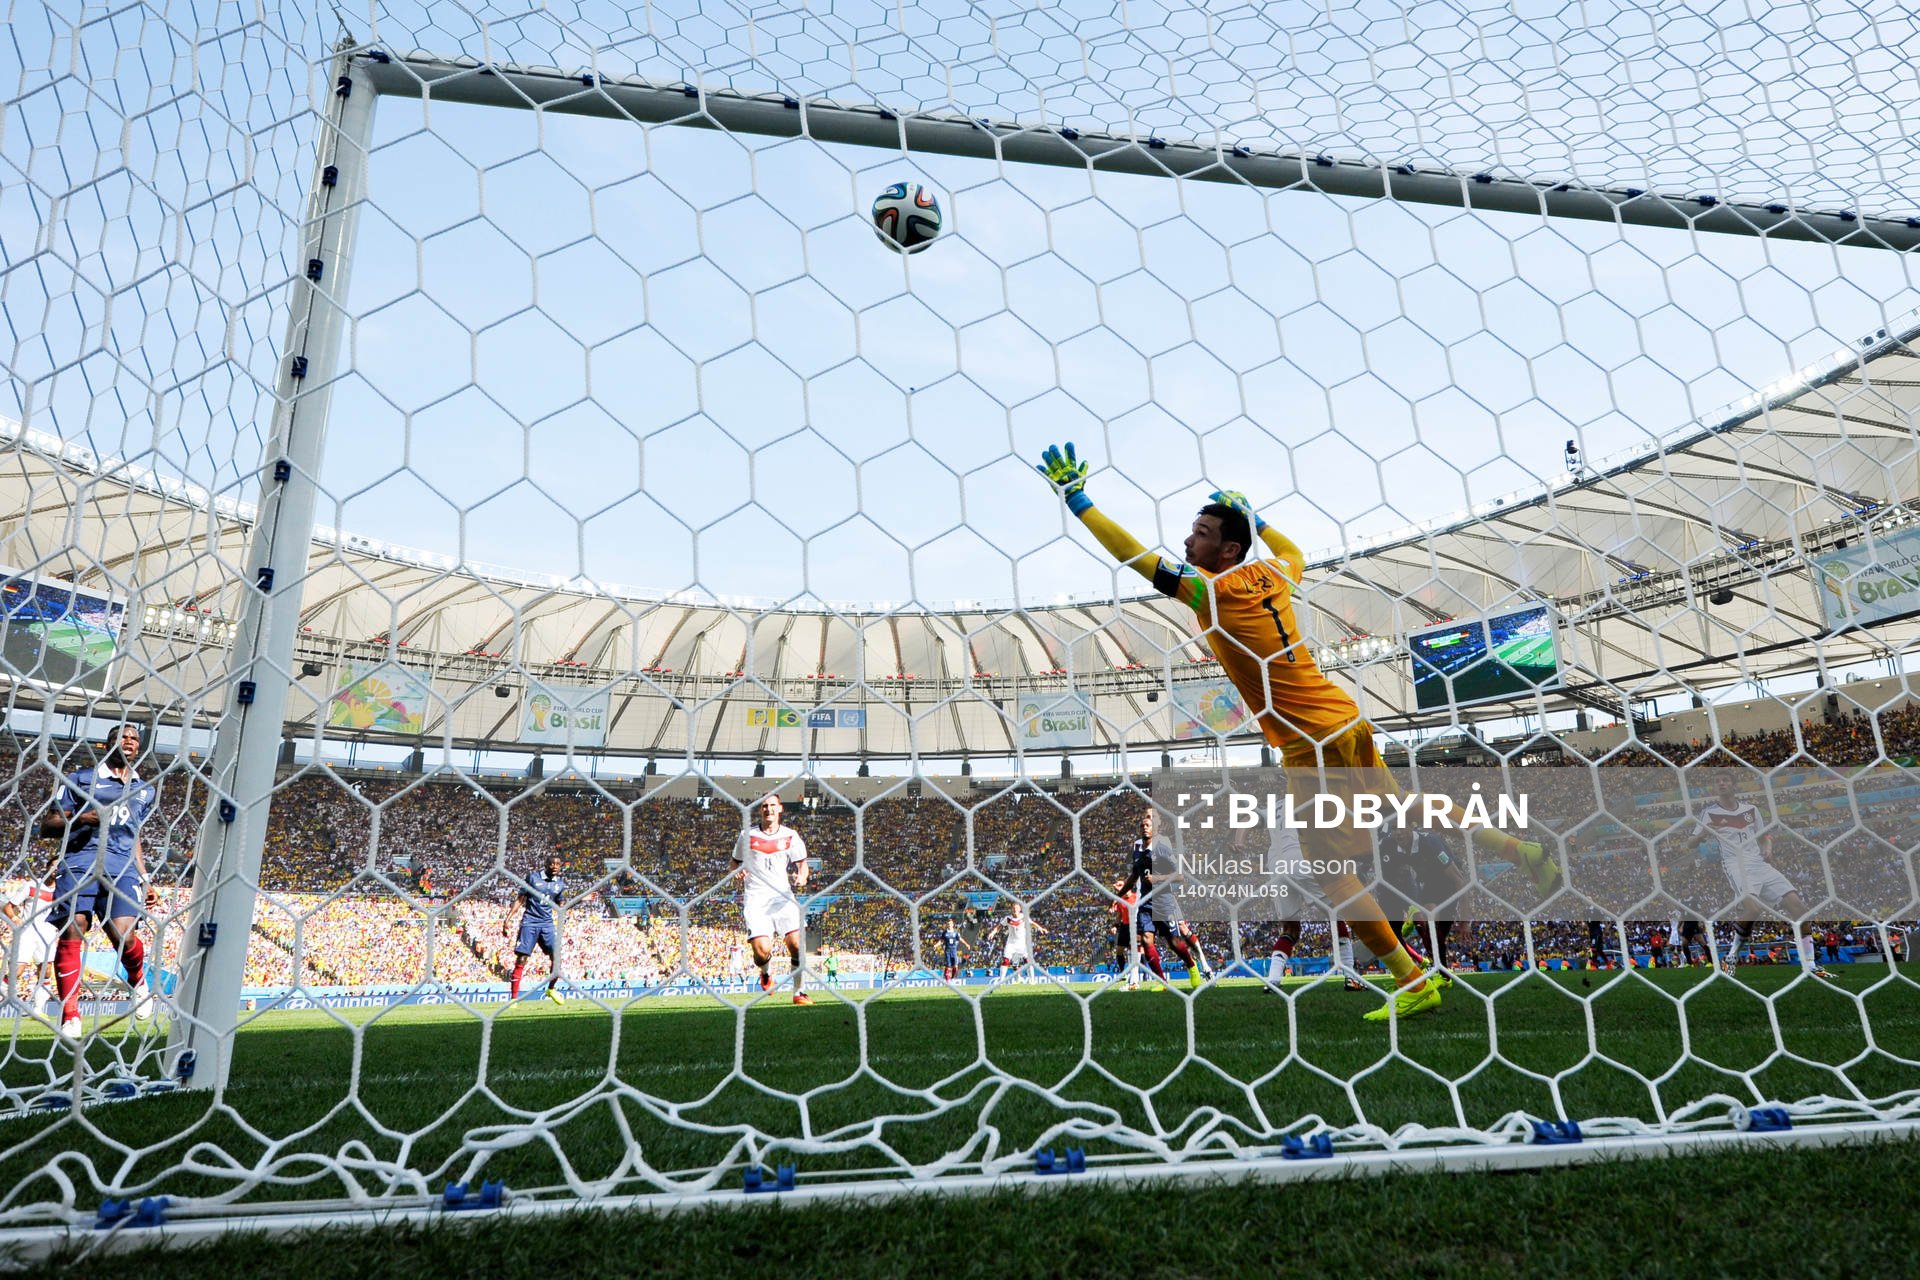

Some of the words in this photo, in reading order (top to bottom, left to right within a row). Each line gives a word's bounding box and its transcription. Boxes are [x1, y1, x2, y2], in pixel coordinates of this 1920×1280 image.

[811, 713, 832, 721] FIFA
[1041, 715, 1088, 733] Brasil
[110, 804, 131, 826] 19
